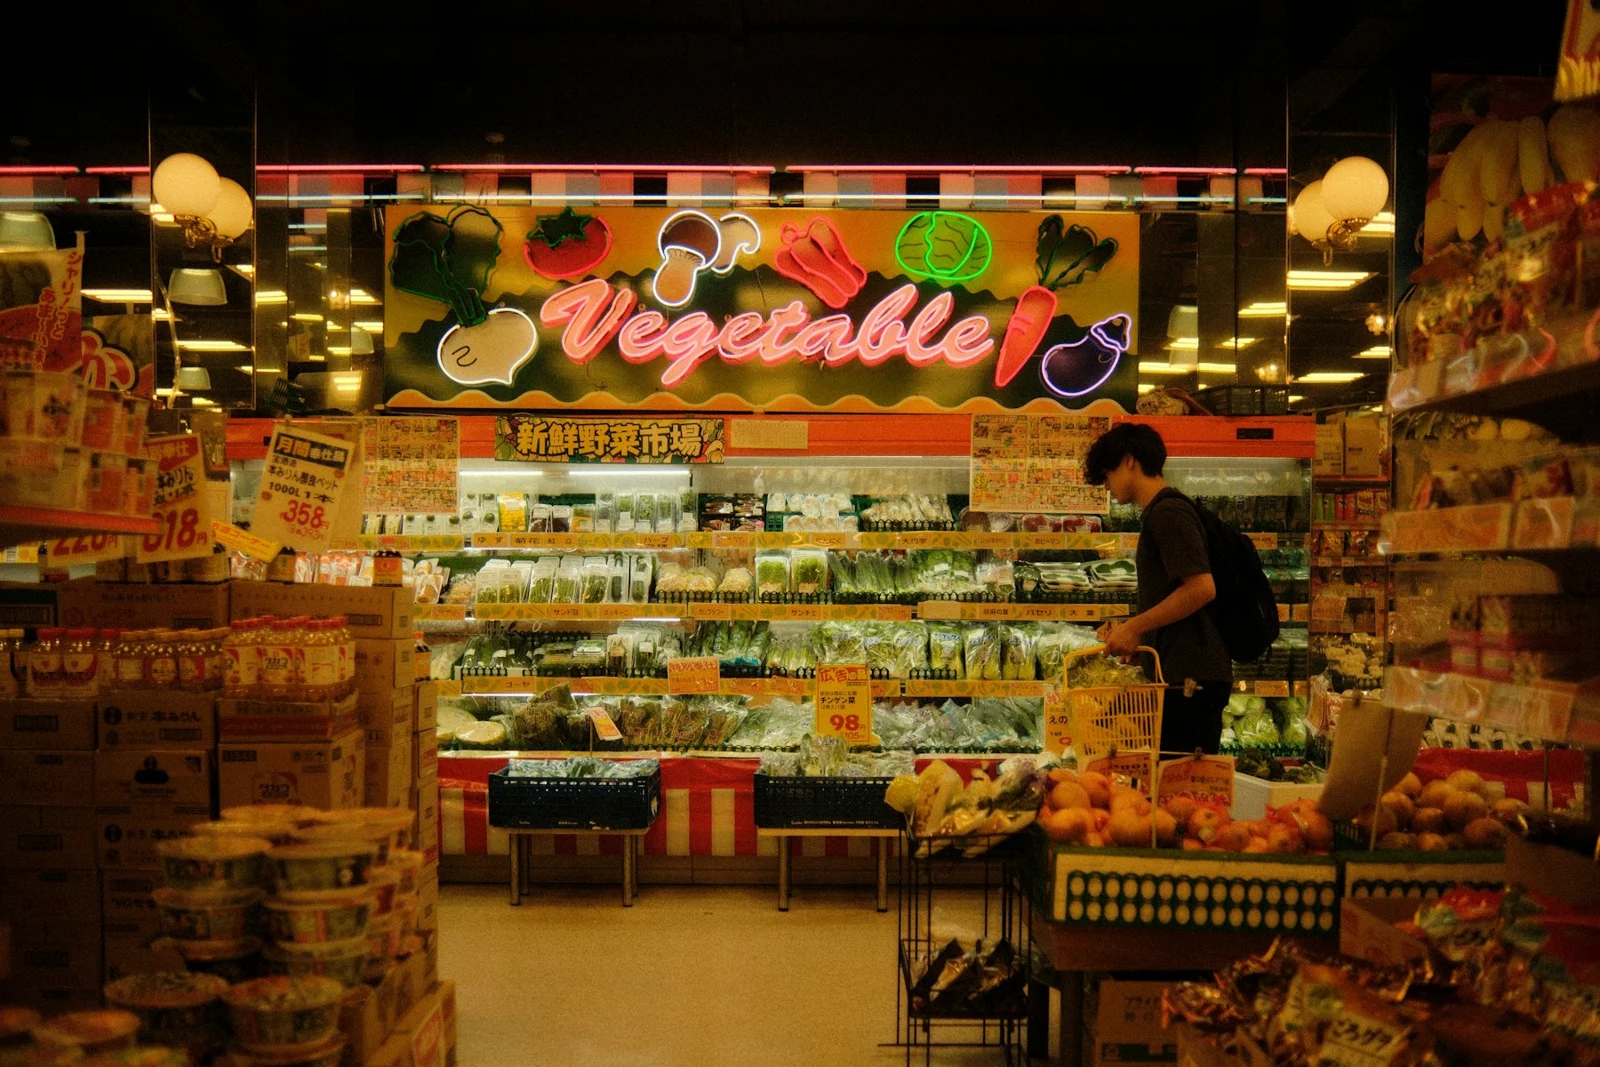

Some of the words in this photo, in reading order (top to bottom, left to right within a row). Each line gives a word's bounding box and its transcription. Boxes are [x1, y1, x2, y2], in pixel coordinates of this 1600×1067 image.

[539, 278, 996, 388] Vegetable
[516, 420, 704, 459] 新鮮野菜市場
[819, 667, 868, 683] 広告の品
[821, 696, 856, 704] チンゲン菜
